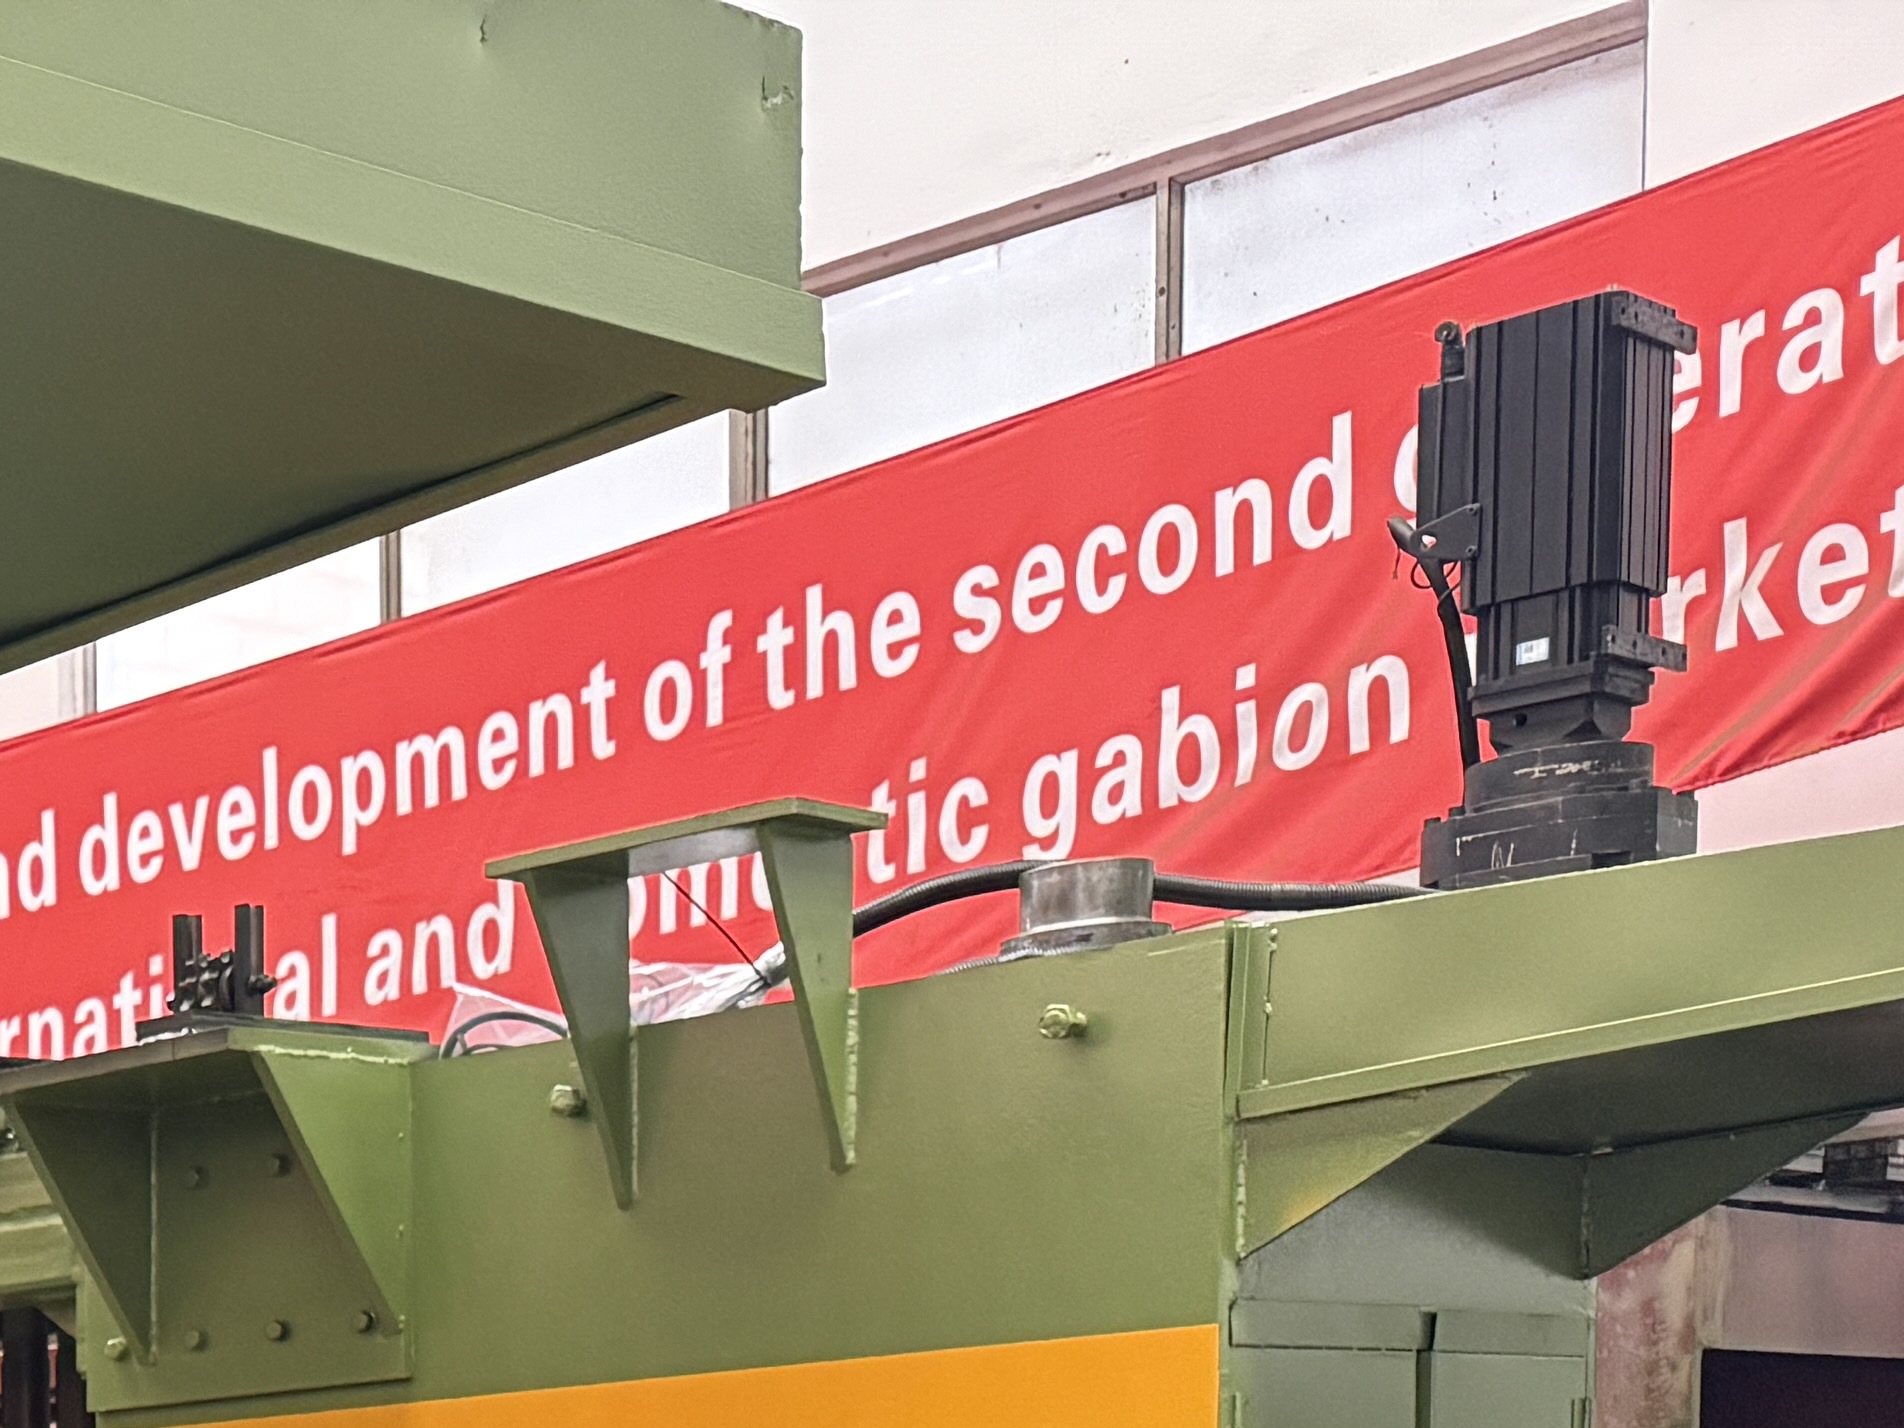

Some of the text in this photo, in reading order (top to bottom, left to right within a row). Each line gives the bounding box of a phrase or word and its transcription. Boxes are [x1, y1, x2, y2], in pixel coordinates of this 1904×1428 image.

[79, 661, 616, 896] development
[643, 609, 733, 741] of
[756, 583, 921, 710] the
[953, 410, 1353, 654] second
[364, 878, 516, 1006] and
[1022, 655, 1410, 861] gabion
[1464, 485, 1904, 689] rket
